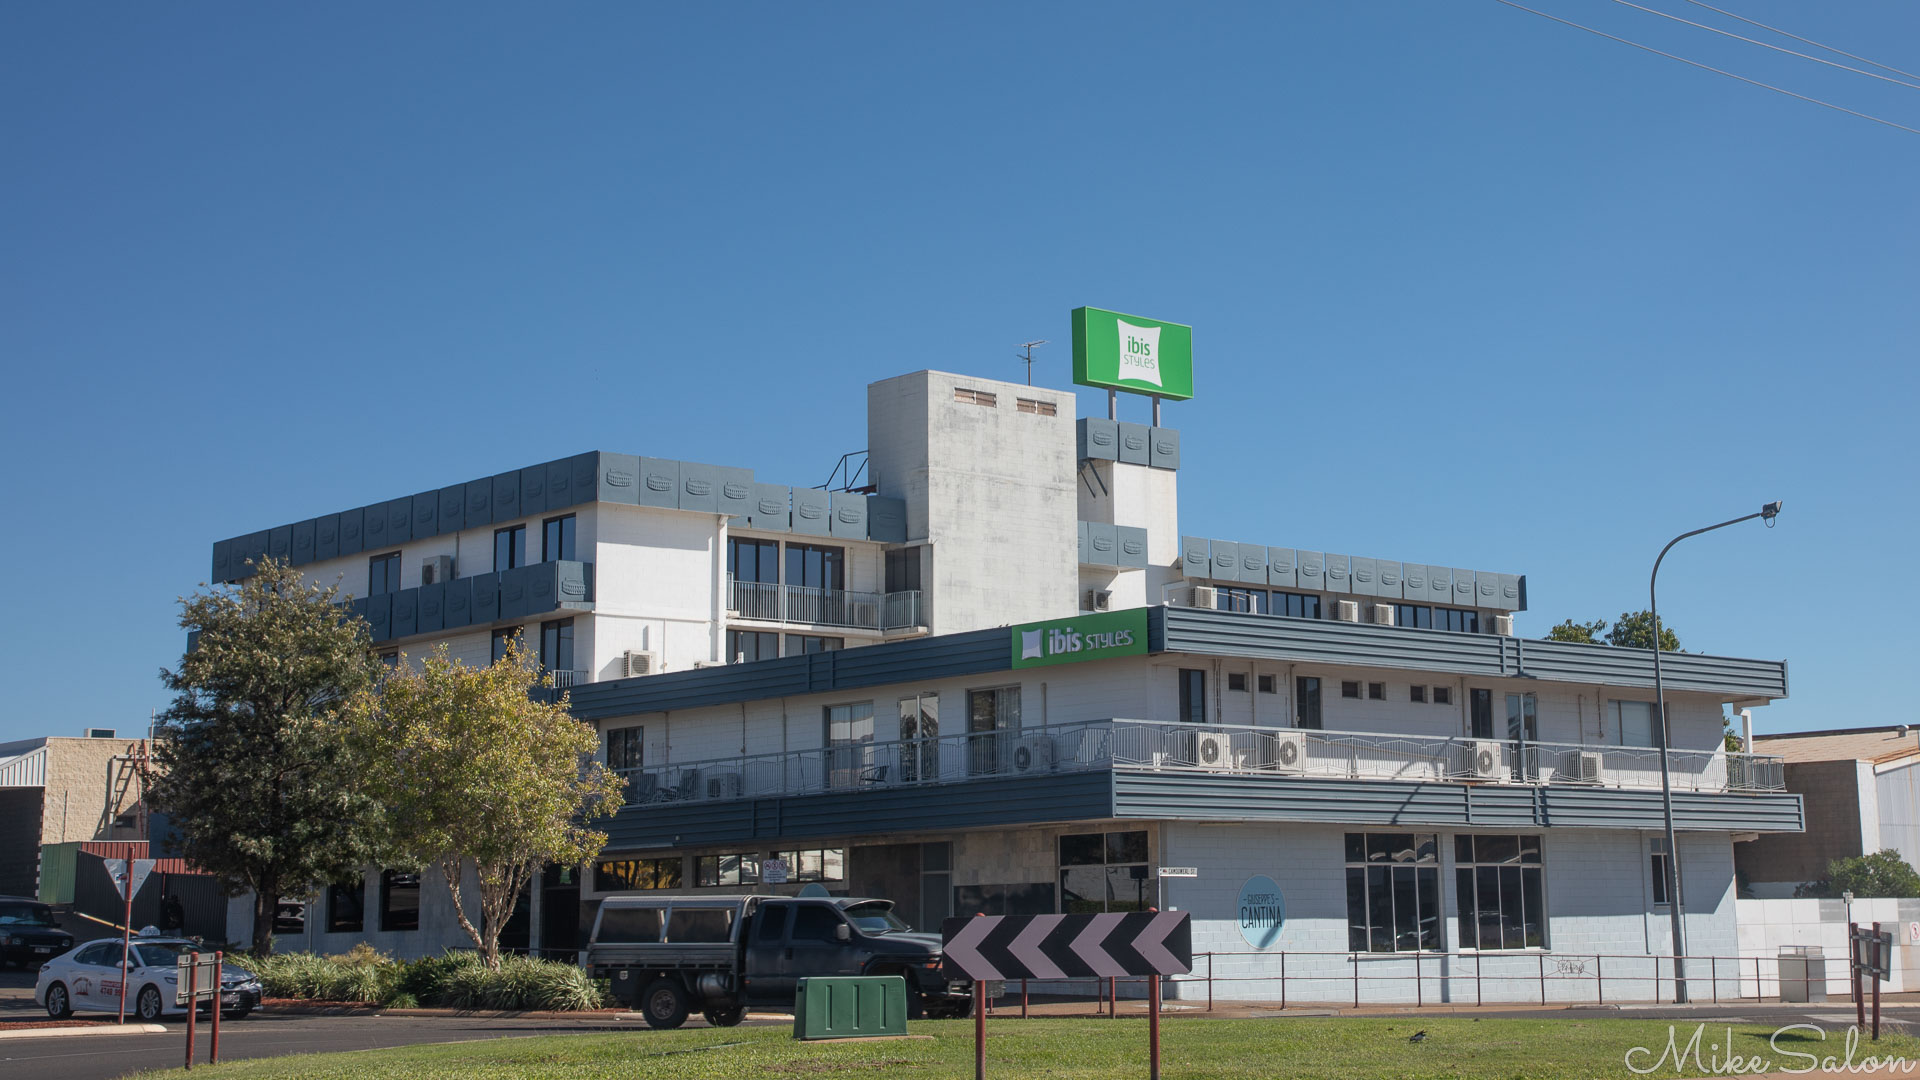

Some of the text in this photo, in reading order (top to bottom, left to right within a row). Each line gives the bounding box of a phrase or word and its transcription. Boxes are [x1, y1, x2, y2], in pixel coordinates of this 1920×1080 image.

[1127, 335, 1150, 356] ibis
[1048, 626, 1083, 655] ibis
[1241, 905, 1283, 929] CANTINA
[143, 928, 160, 936] TAXI
